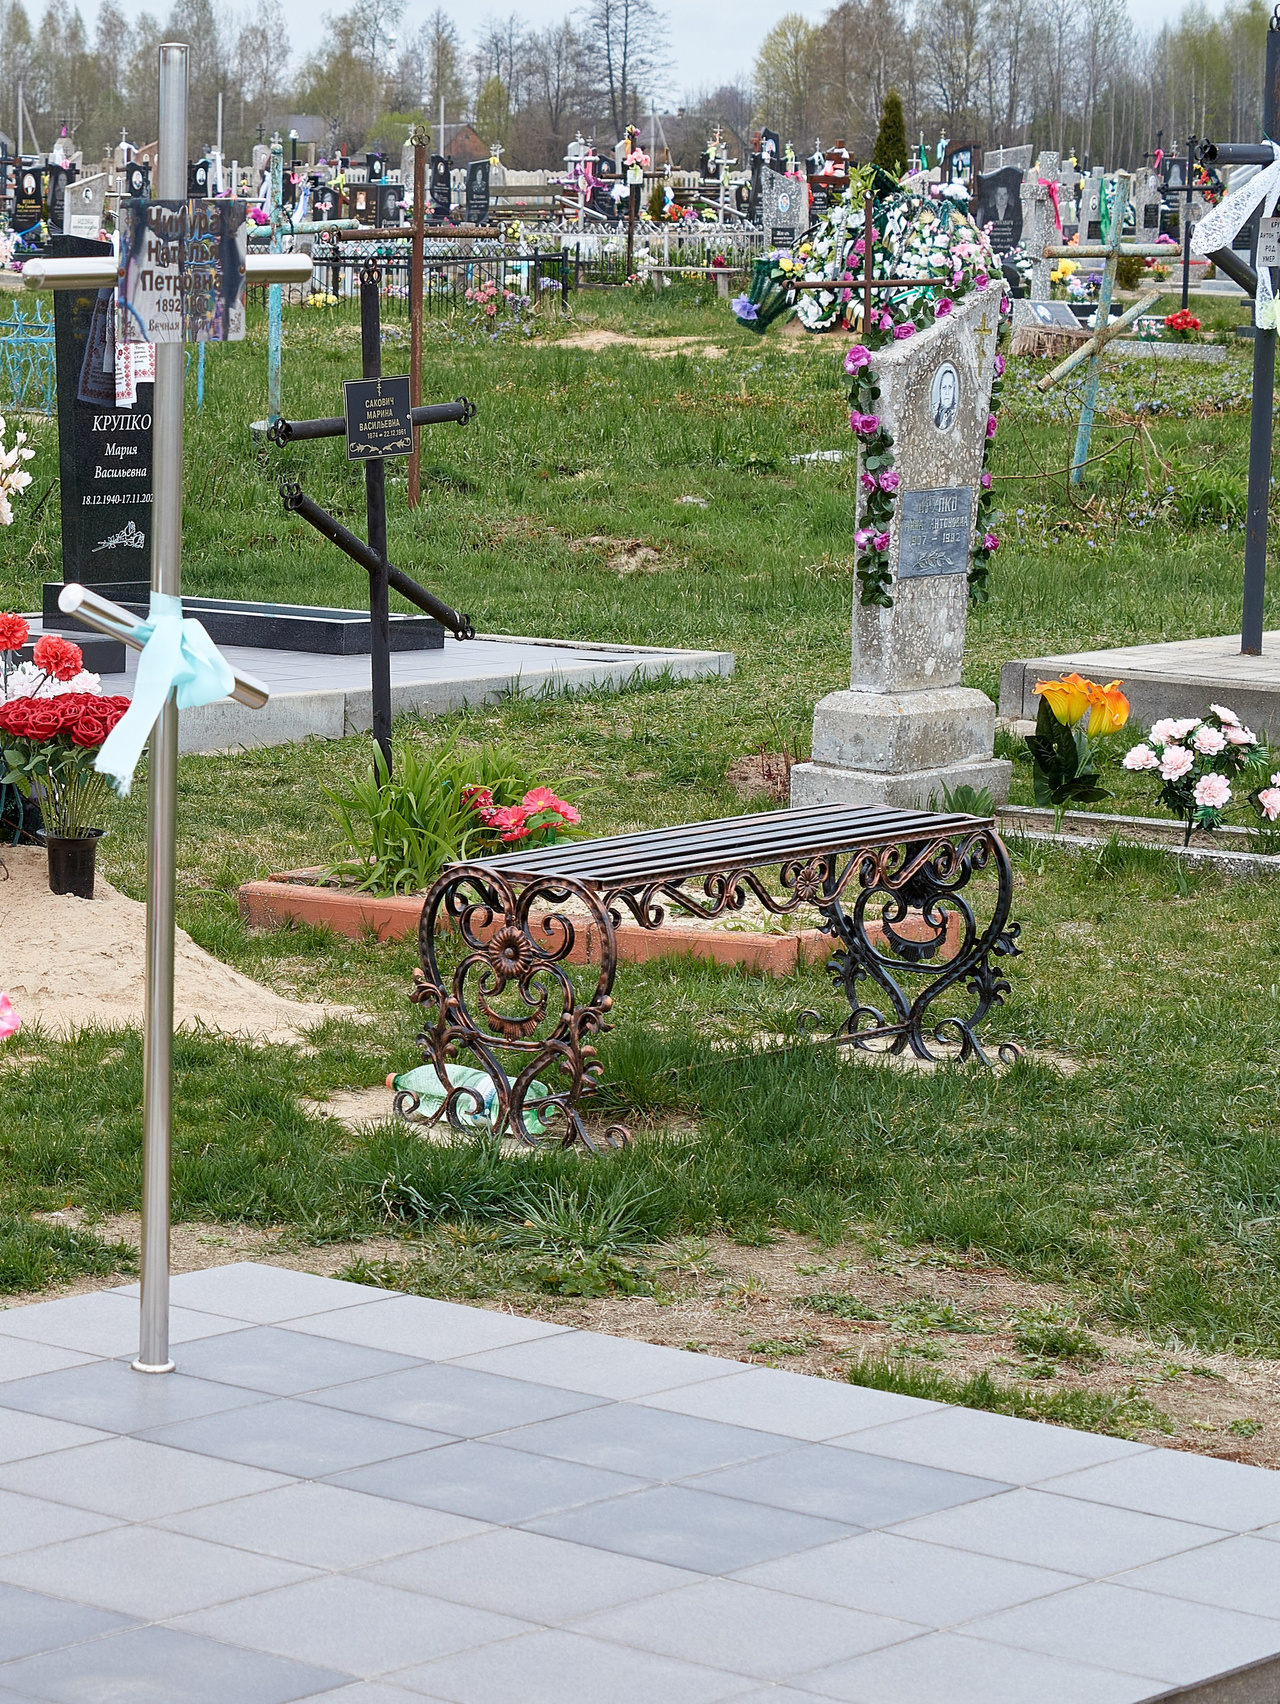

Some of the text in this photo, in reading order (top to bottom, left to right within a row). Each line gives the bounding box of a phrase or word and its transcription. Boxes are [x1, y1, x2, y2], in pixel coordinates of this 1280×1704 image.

[147, 207, 221, 240] Чипура
[141, 270, 222, 297] Петровна
[148, 318, 180, 332] Вечная
[365, 397, 394, 408] САКОВИЧ
[366, 408, 394, 419] МАРИНА
[92, 414, 152, 431] КРУПКО
[359, 419, 400, 431] ВАСИЛЬЕВНА
[104, 443, 138, 459] Мария
[94, 466, 147, 479] Васильевна
[81, 493, 154, 505] 18.12.1940-17.11.202
